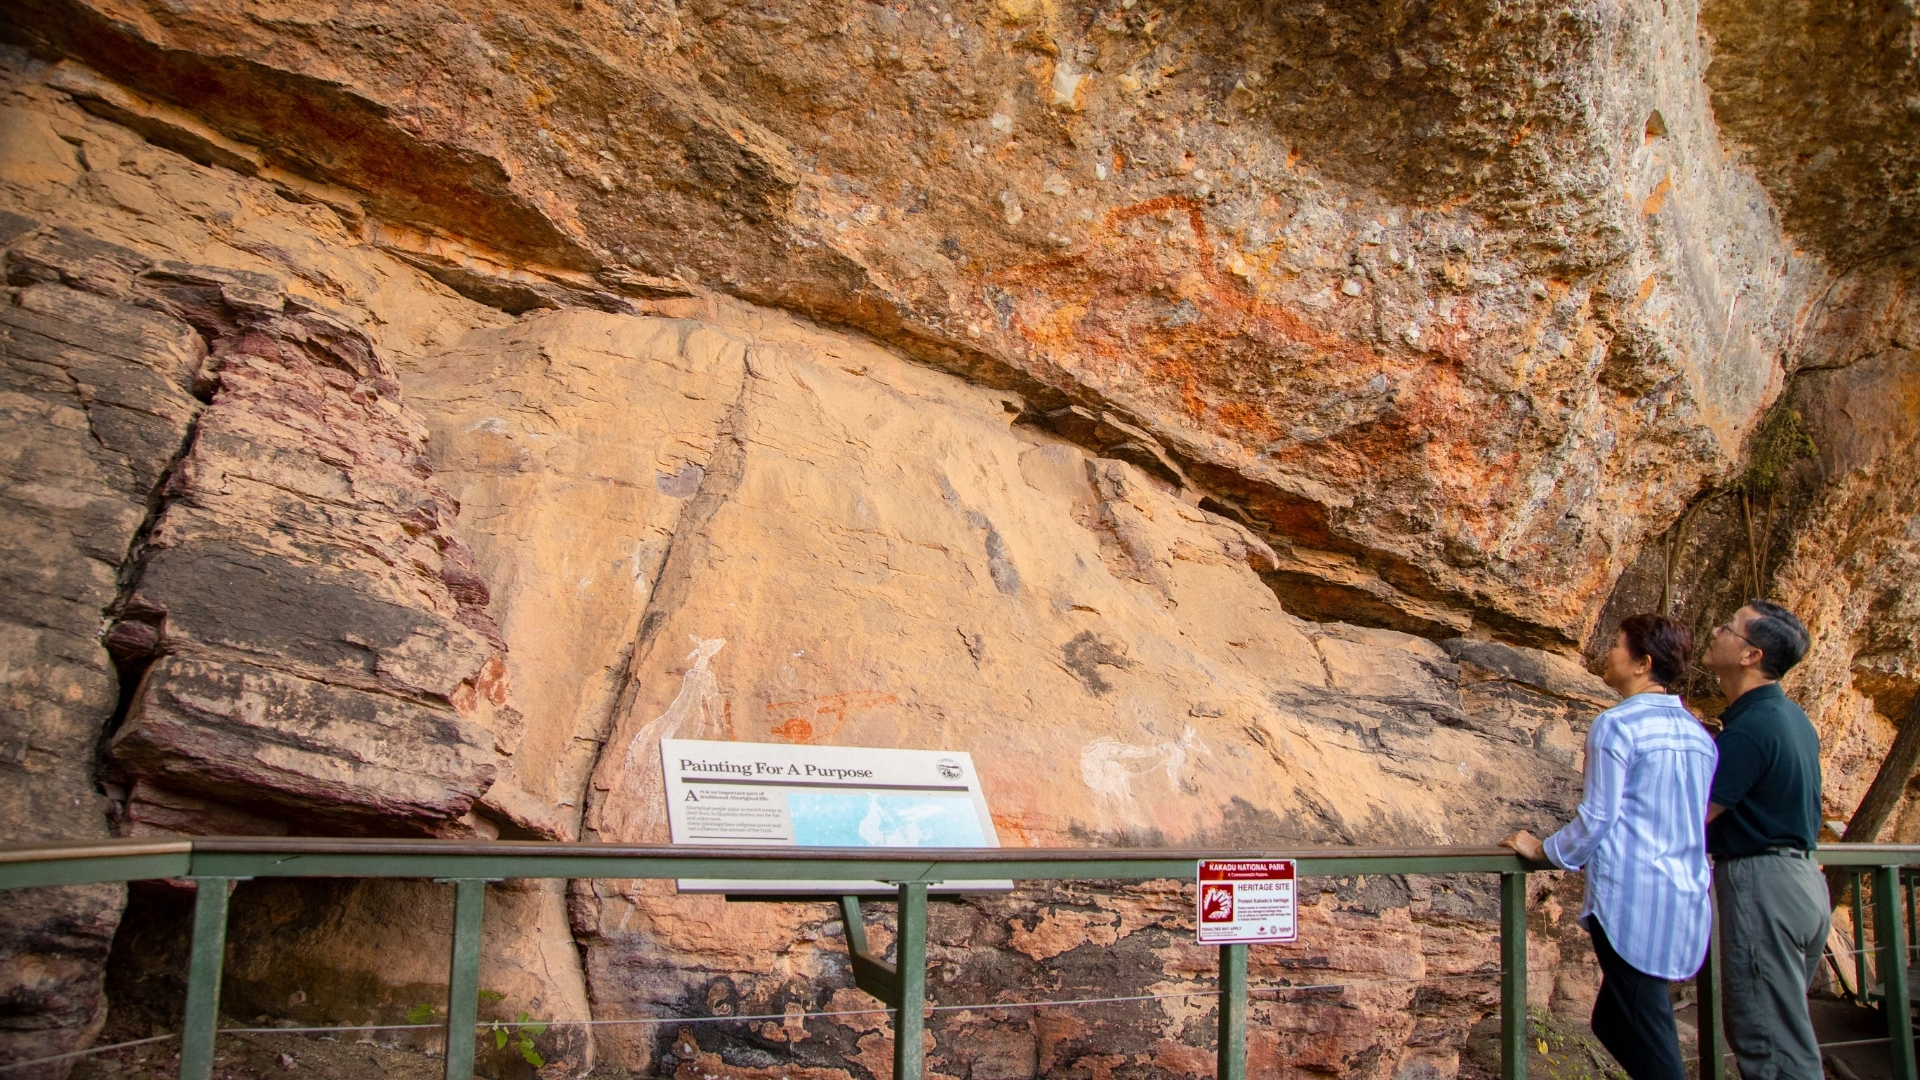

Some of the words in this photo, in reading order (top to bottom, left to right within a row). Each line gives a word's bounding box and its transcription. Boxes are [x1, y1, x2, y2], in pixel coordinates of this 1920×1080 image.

[679, 759, 752, 776] Painting
[754, 762, 783, 774] For
[787, 764, 801, 776] A
[804, 764, 873, 780] Purpose
[684, 790, 699, 801] A
